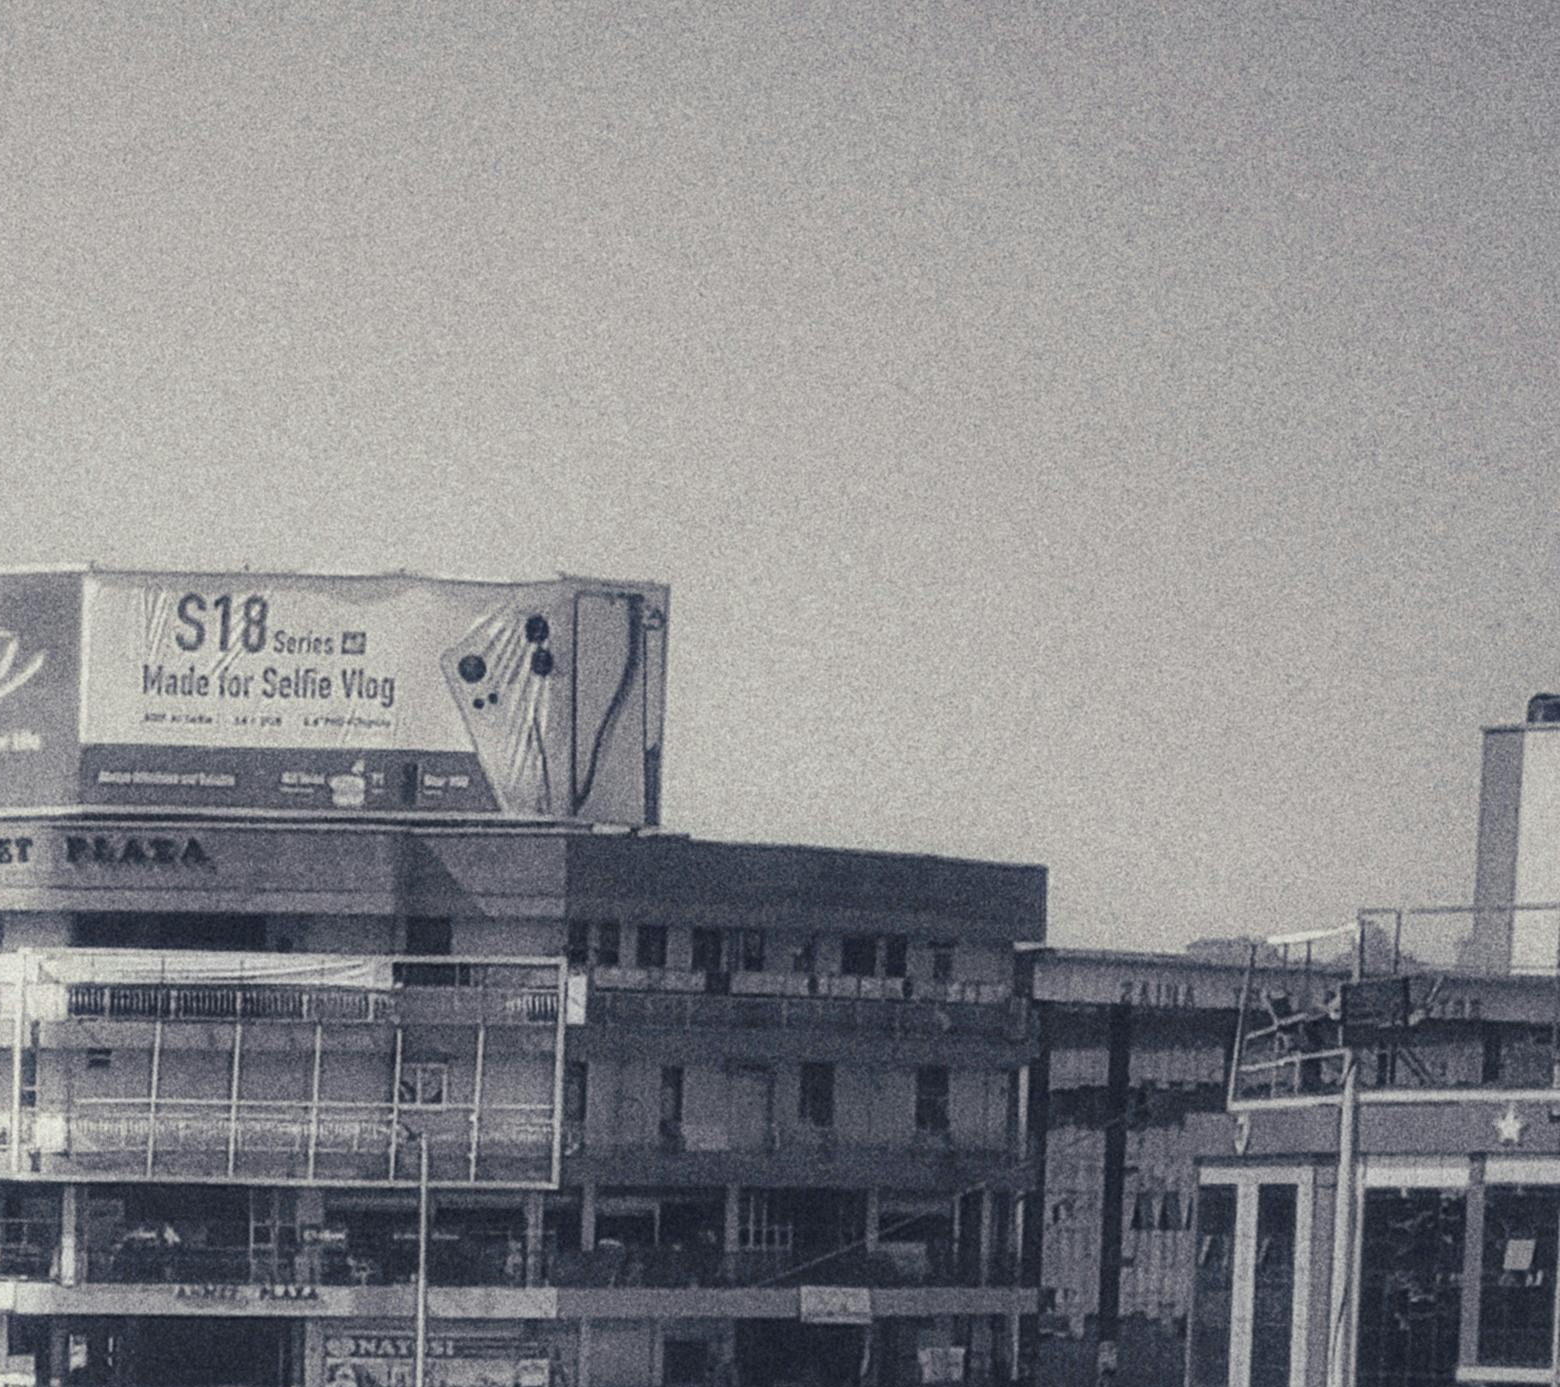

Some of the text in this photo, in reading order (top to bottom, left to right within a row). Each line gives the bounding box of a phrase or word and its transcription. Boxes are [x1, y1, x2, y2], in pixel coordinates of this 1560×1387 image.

[175, 592, 269, 653] S18
[273, 629, 334, 656] Series
[142, 664, 396, 709] Made for Selfie Vlog
